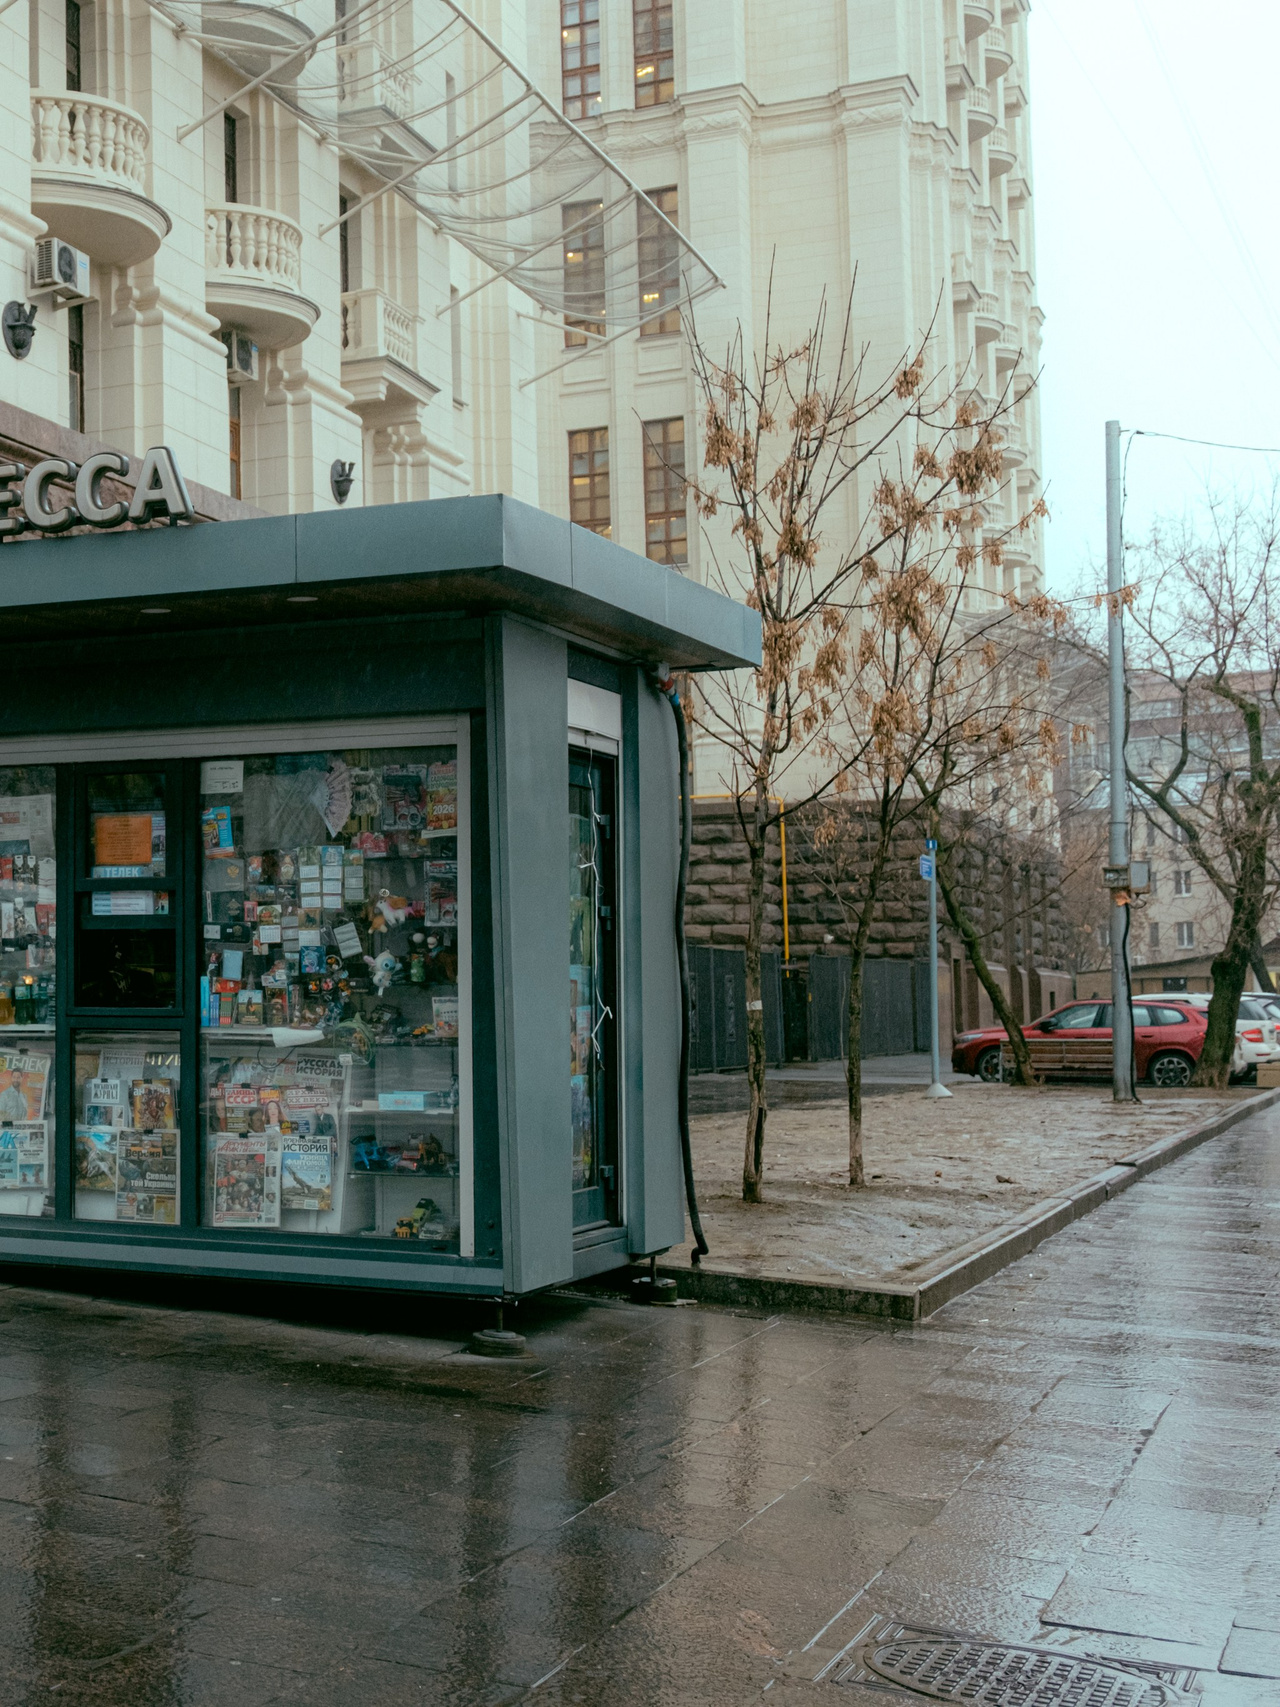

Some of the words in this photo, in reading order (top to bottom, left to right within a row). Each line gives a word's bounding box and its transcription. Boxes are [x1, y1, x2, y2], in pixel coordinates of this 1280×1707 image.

[432, 804, 455, 814] 2026
[105, 867, 139, 878] ТЕЛЕК
[145, 1054, 180, 1066] ЧТИ
[297, 1058, 343, 1069] РУССКАЯ
[296, 1066, 343, 1077] ИСТОРИЯ
[227, 1095, 256, 1104] СССР
[125, 1148, 161, 1159] Версия
[283, 1144, 328, 1153] ИСТОРИЯ
